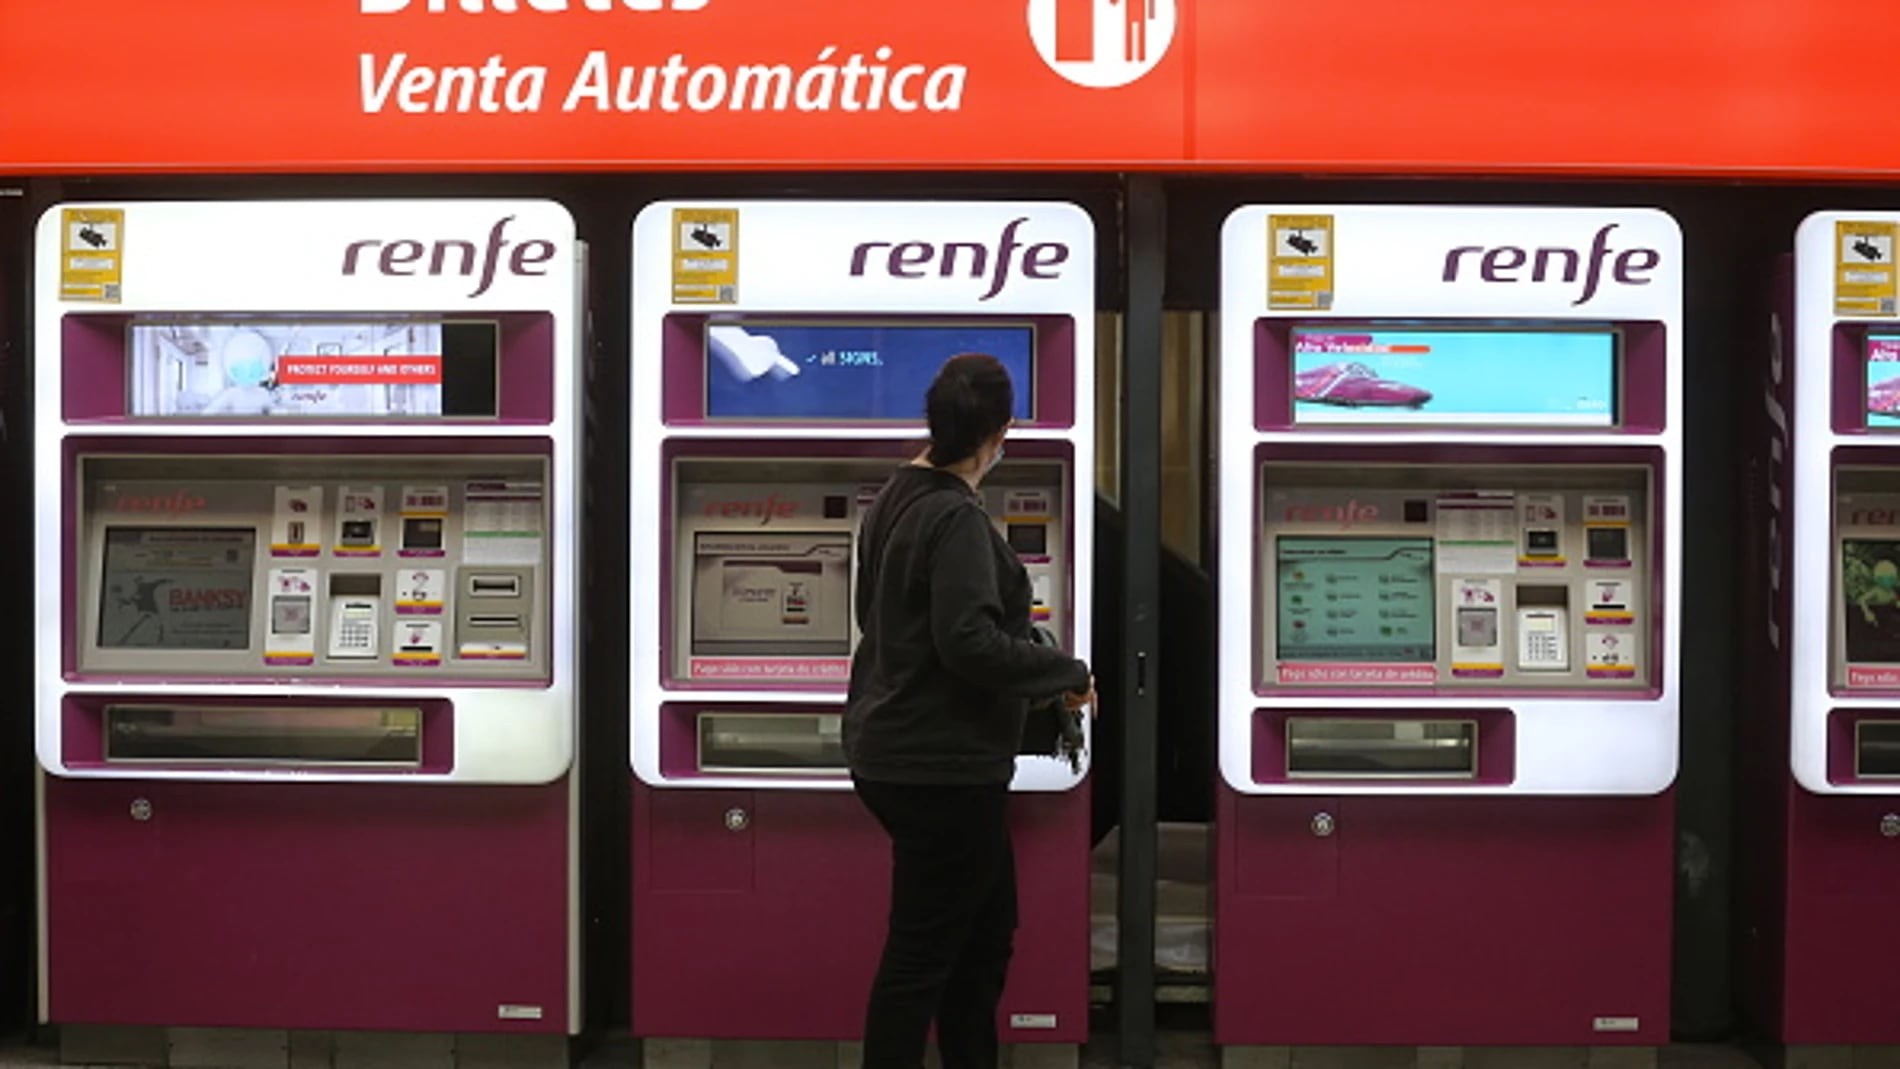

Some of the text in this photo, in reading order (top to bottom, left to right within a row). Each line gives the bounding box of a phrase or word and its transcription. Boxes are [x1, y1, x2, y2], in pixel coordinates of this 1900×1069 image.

[360, 46, 967, 113] Venta Automática
[342, 217, 555, 298] renfe
[850, 217, 1069, 301] renfe
[1443, 224, 1660, 305] renfe
[703, 491, 801, 525] renfe
[169, 587, 247, 608] BANKSY
